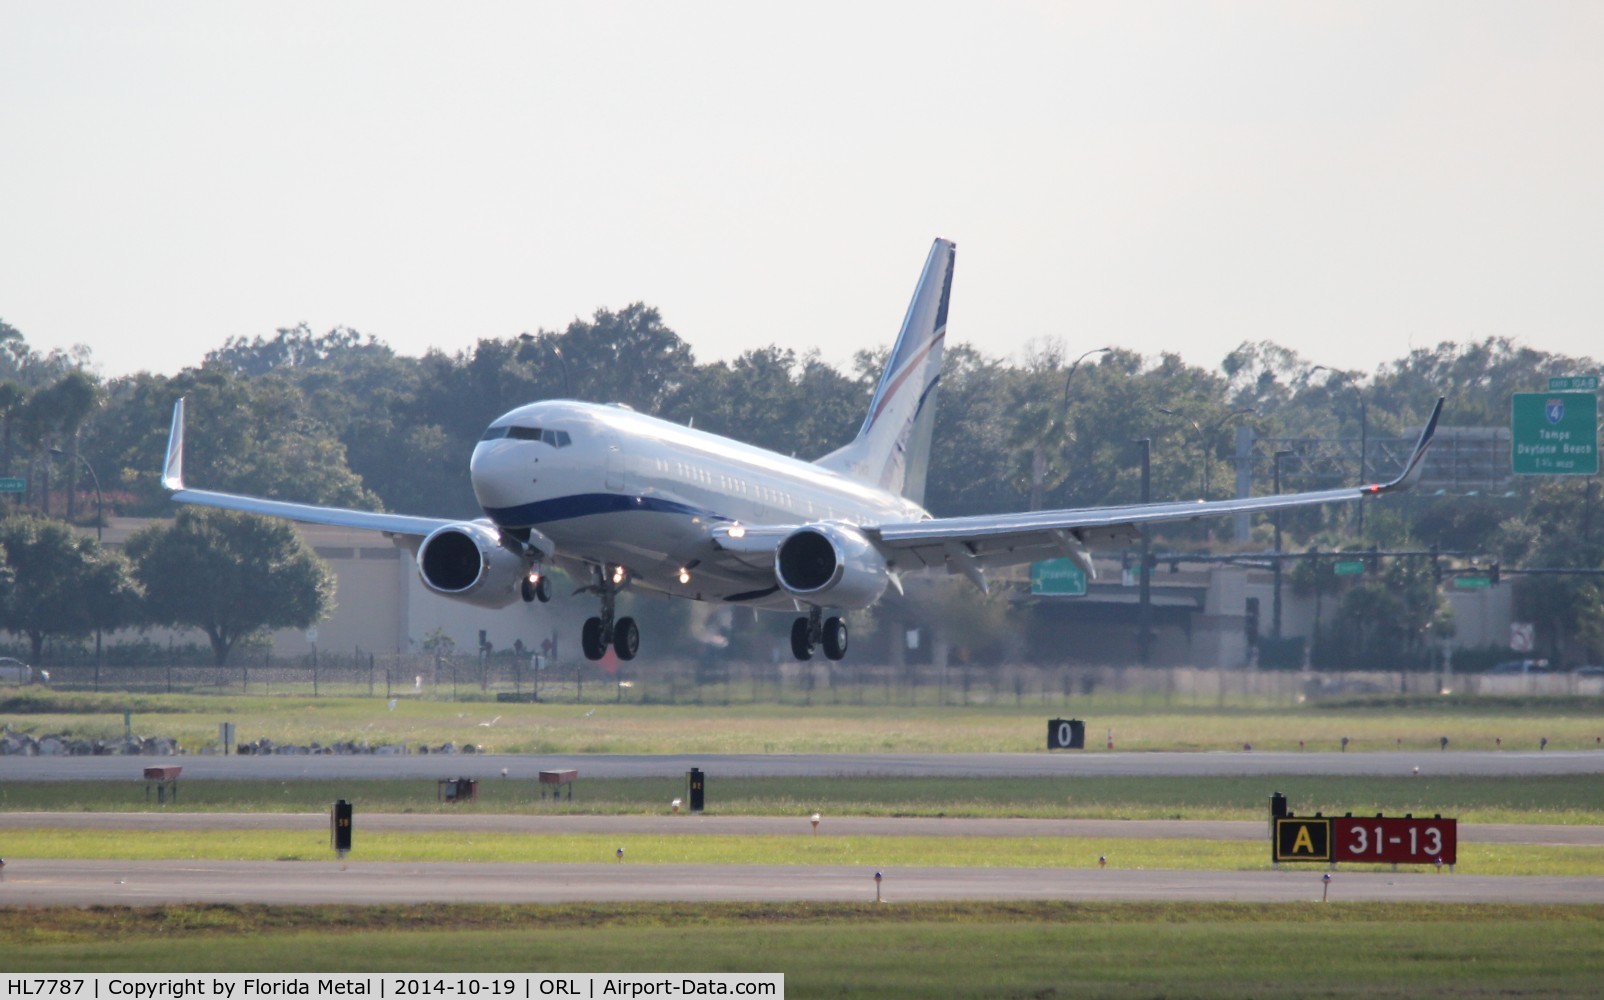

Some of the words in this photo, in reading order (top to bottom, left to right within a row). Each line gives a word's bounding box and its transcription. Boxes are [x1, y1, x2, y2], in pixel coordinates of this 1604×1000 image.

[1551, 405, 1559, 420] 4
[1540, 429, 1570, 441] Tampa
[1518, 443, 1557, 456] Daytona
[1563, 443, 1592, 454] Beach
[1058, 722, 1072, 747] 0
[1292, 825, 1314, 853] A
[1349, 826, 1442, 855] 31-13
